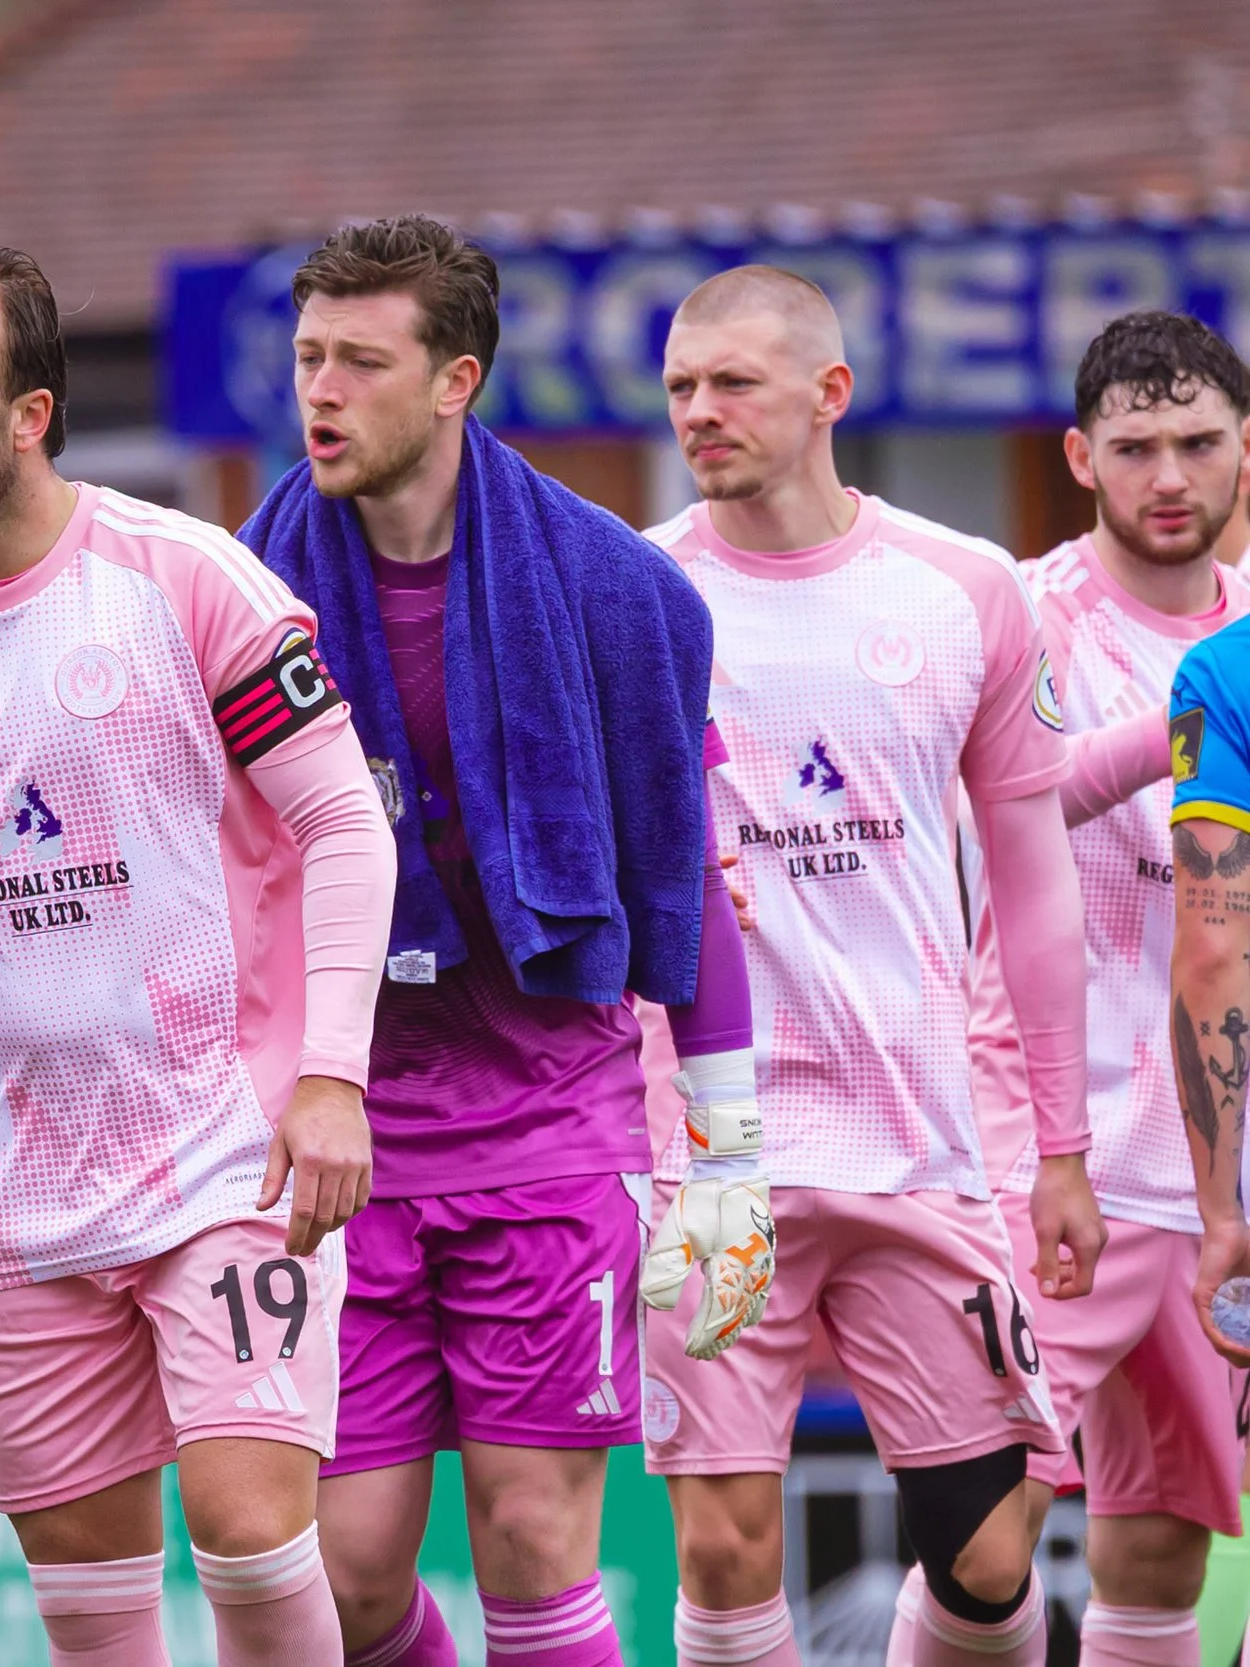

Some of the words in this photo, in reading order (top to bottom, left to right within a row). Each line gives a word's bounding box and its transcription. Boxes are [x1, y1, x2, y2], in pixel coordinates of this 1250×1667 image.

[279, 654, 326, 708] C
[833, 818, 905, 842] STEELS
[53, 861, 130, 893] STEELS
[788, 856, 818, 879] UK
[823, 851, 867, 876] LTD.
[1137, 857, 1174, 884] REG
[9, 907, 43, 932] UK
[44, 900, 92, 928] LTD.
[210, 1258, 308, 1364] 19
[589, 1271, 615, 1376] 1
[962, 1281, 1040, 1377] 16
